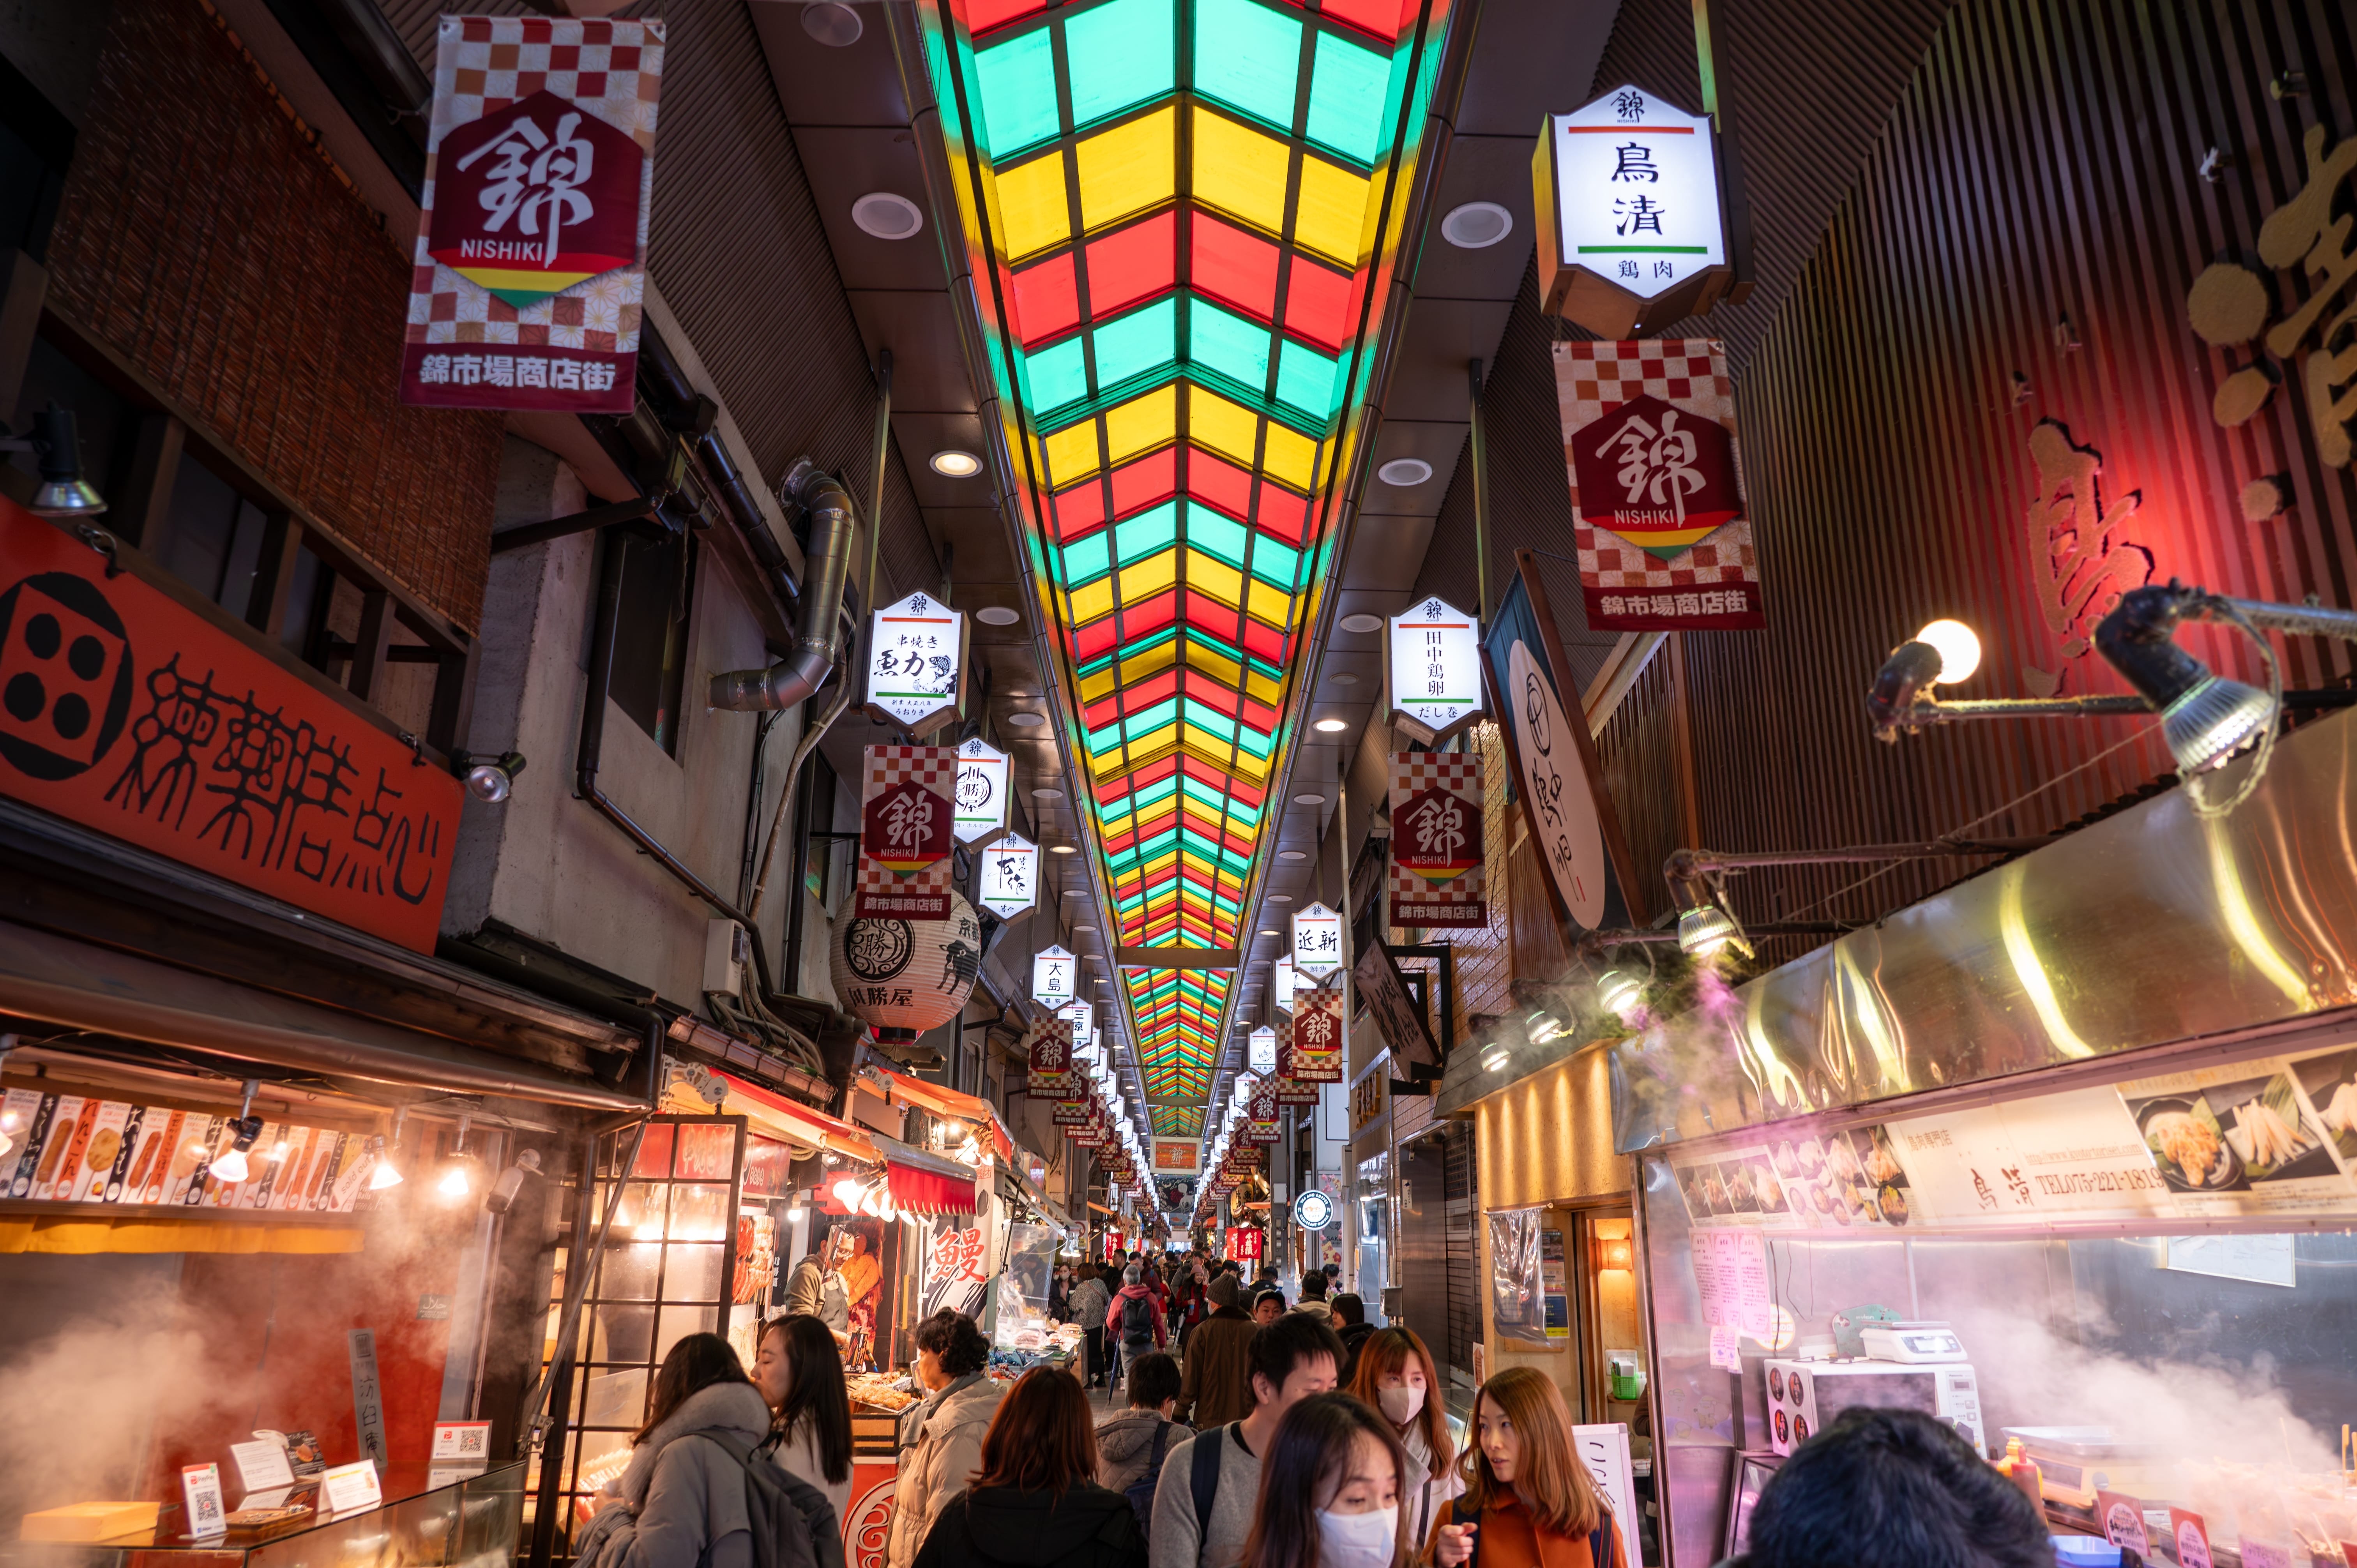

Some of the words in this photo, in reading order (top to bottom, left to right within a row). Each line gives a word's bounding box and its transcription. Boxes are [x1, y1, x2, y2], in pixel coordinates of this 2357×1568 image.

[1610, 91, 1645, 123] 錦
[457, 112, 594, 268] 錦
[1611, 142, 1665, 235] 鳥清
[461, 239, 543, 262] NISHIKI
[1618, 260, 1673, 280] 鶏肉
[420, 354, 616, 391] 錦市場商店街
[1596, 410, 1706, 527] 錦
[1615, 508, 1675, 524] NISHIKI
[908, 595, 926, 616] 錦
[1423, 601, 1442, 622] 錦
[1601, 590, 1748, 616] 錦市場商店街
[897, 634, 937, 648] 串焼き
[874, 650, 924, 676] 魚力
[1426, 631, 1444, 696] 田中鶏卵
[1419, 706, 1458, 718] だし巻
[967, 741, 981, 757] 錦
[962, 766, 981, 812] 川勝屋
[878, 790, 933, 860] 錦
[1405, 797, 1465, 867] 錦
[1005, 832, 1016, 848] 錦
[881, 848, 913, 857] NISHIKI
[1412, 855, 1447, 864] NISHIKI
[864, 897, 942, 912] 錦市場商店街
[1311, 906, 1322, 918] 錦
[1398, 905, 1478, 920] 錦市場商店街
[863, 933, 892, 958] 勝
[1298, 929, 1337, 952] 近新
[1051, 946, 1059, 957] 錦
[1048, 962, 1062, 991] 大島
[848, 987, 913, 1007] 川勝屋
[1074, 1010, 1084, 1031] 三京
[1301, 1012, 1332, 1051] 錦
[1036, 1038, 1062, 1072] 錦
[1297, 1070, 1339, 1079] 錦市場商店街
[1030, 1089, 1067, 1097] 錦市場商店街
[1279, 1094, 1316, 1102] 錦市場商店街
[1254, 1097, 1274, 1122] 錦
[1170, 1147, 1183, 1166] 錦
[341, 1171, 357, 1194] sold
[358, 1157, 371, 1173] out
[1316, 1193, 1329, 1205] COFFEE
[1299, 1214, 1317, 1227] CROISSANT
[930, 1226, 986, 1284] 鰻
